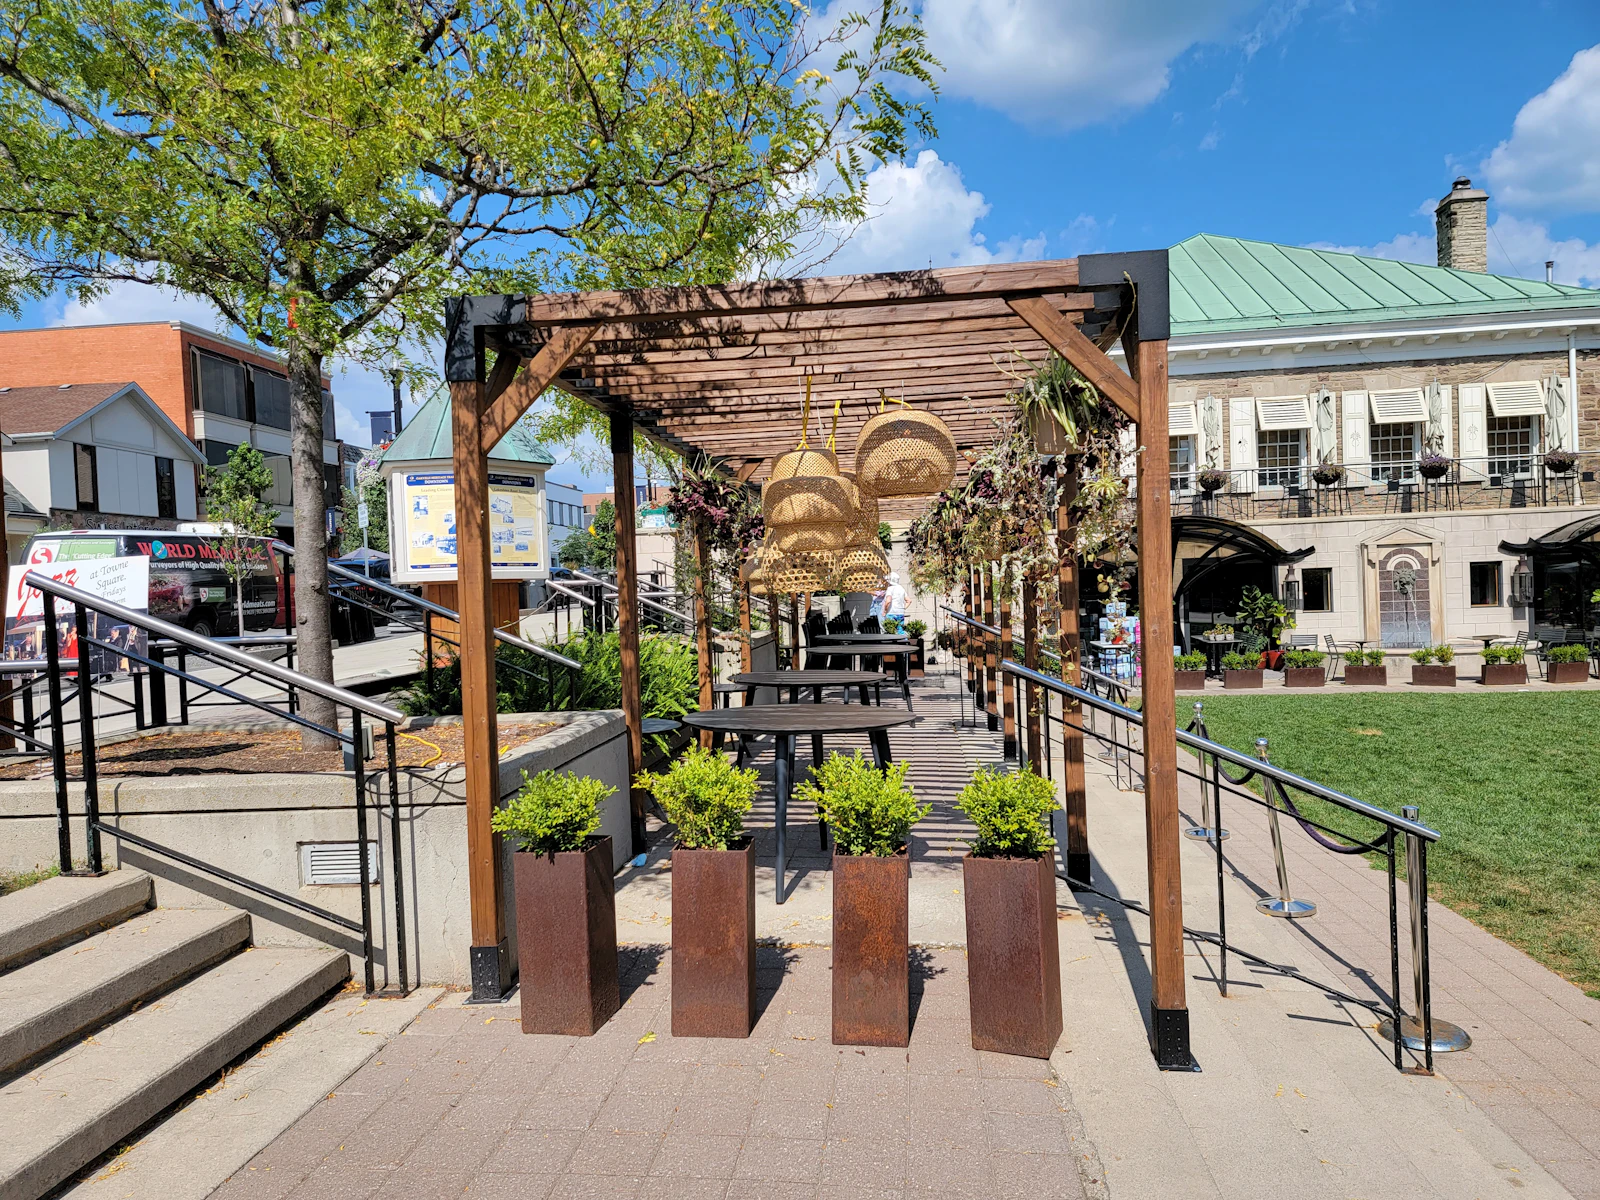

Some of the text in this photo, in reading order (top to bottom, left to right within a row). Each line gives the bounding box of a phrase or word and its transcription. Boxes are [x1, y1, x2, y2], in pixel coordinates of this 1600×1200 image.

[137, 540, 196, 560] WORLD
[89, 560, 129, 580] at Towne
[149, 561, 177, 571] urveyors
[178, 561, 185, 569] of
[185, 561, 199, 571] High
[200, 561, 220, 571] Quality
[101, 585, 127, 599] Fridays
[233, 600, 276, 610] wrldmeats.com
